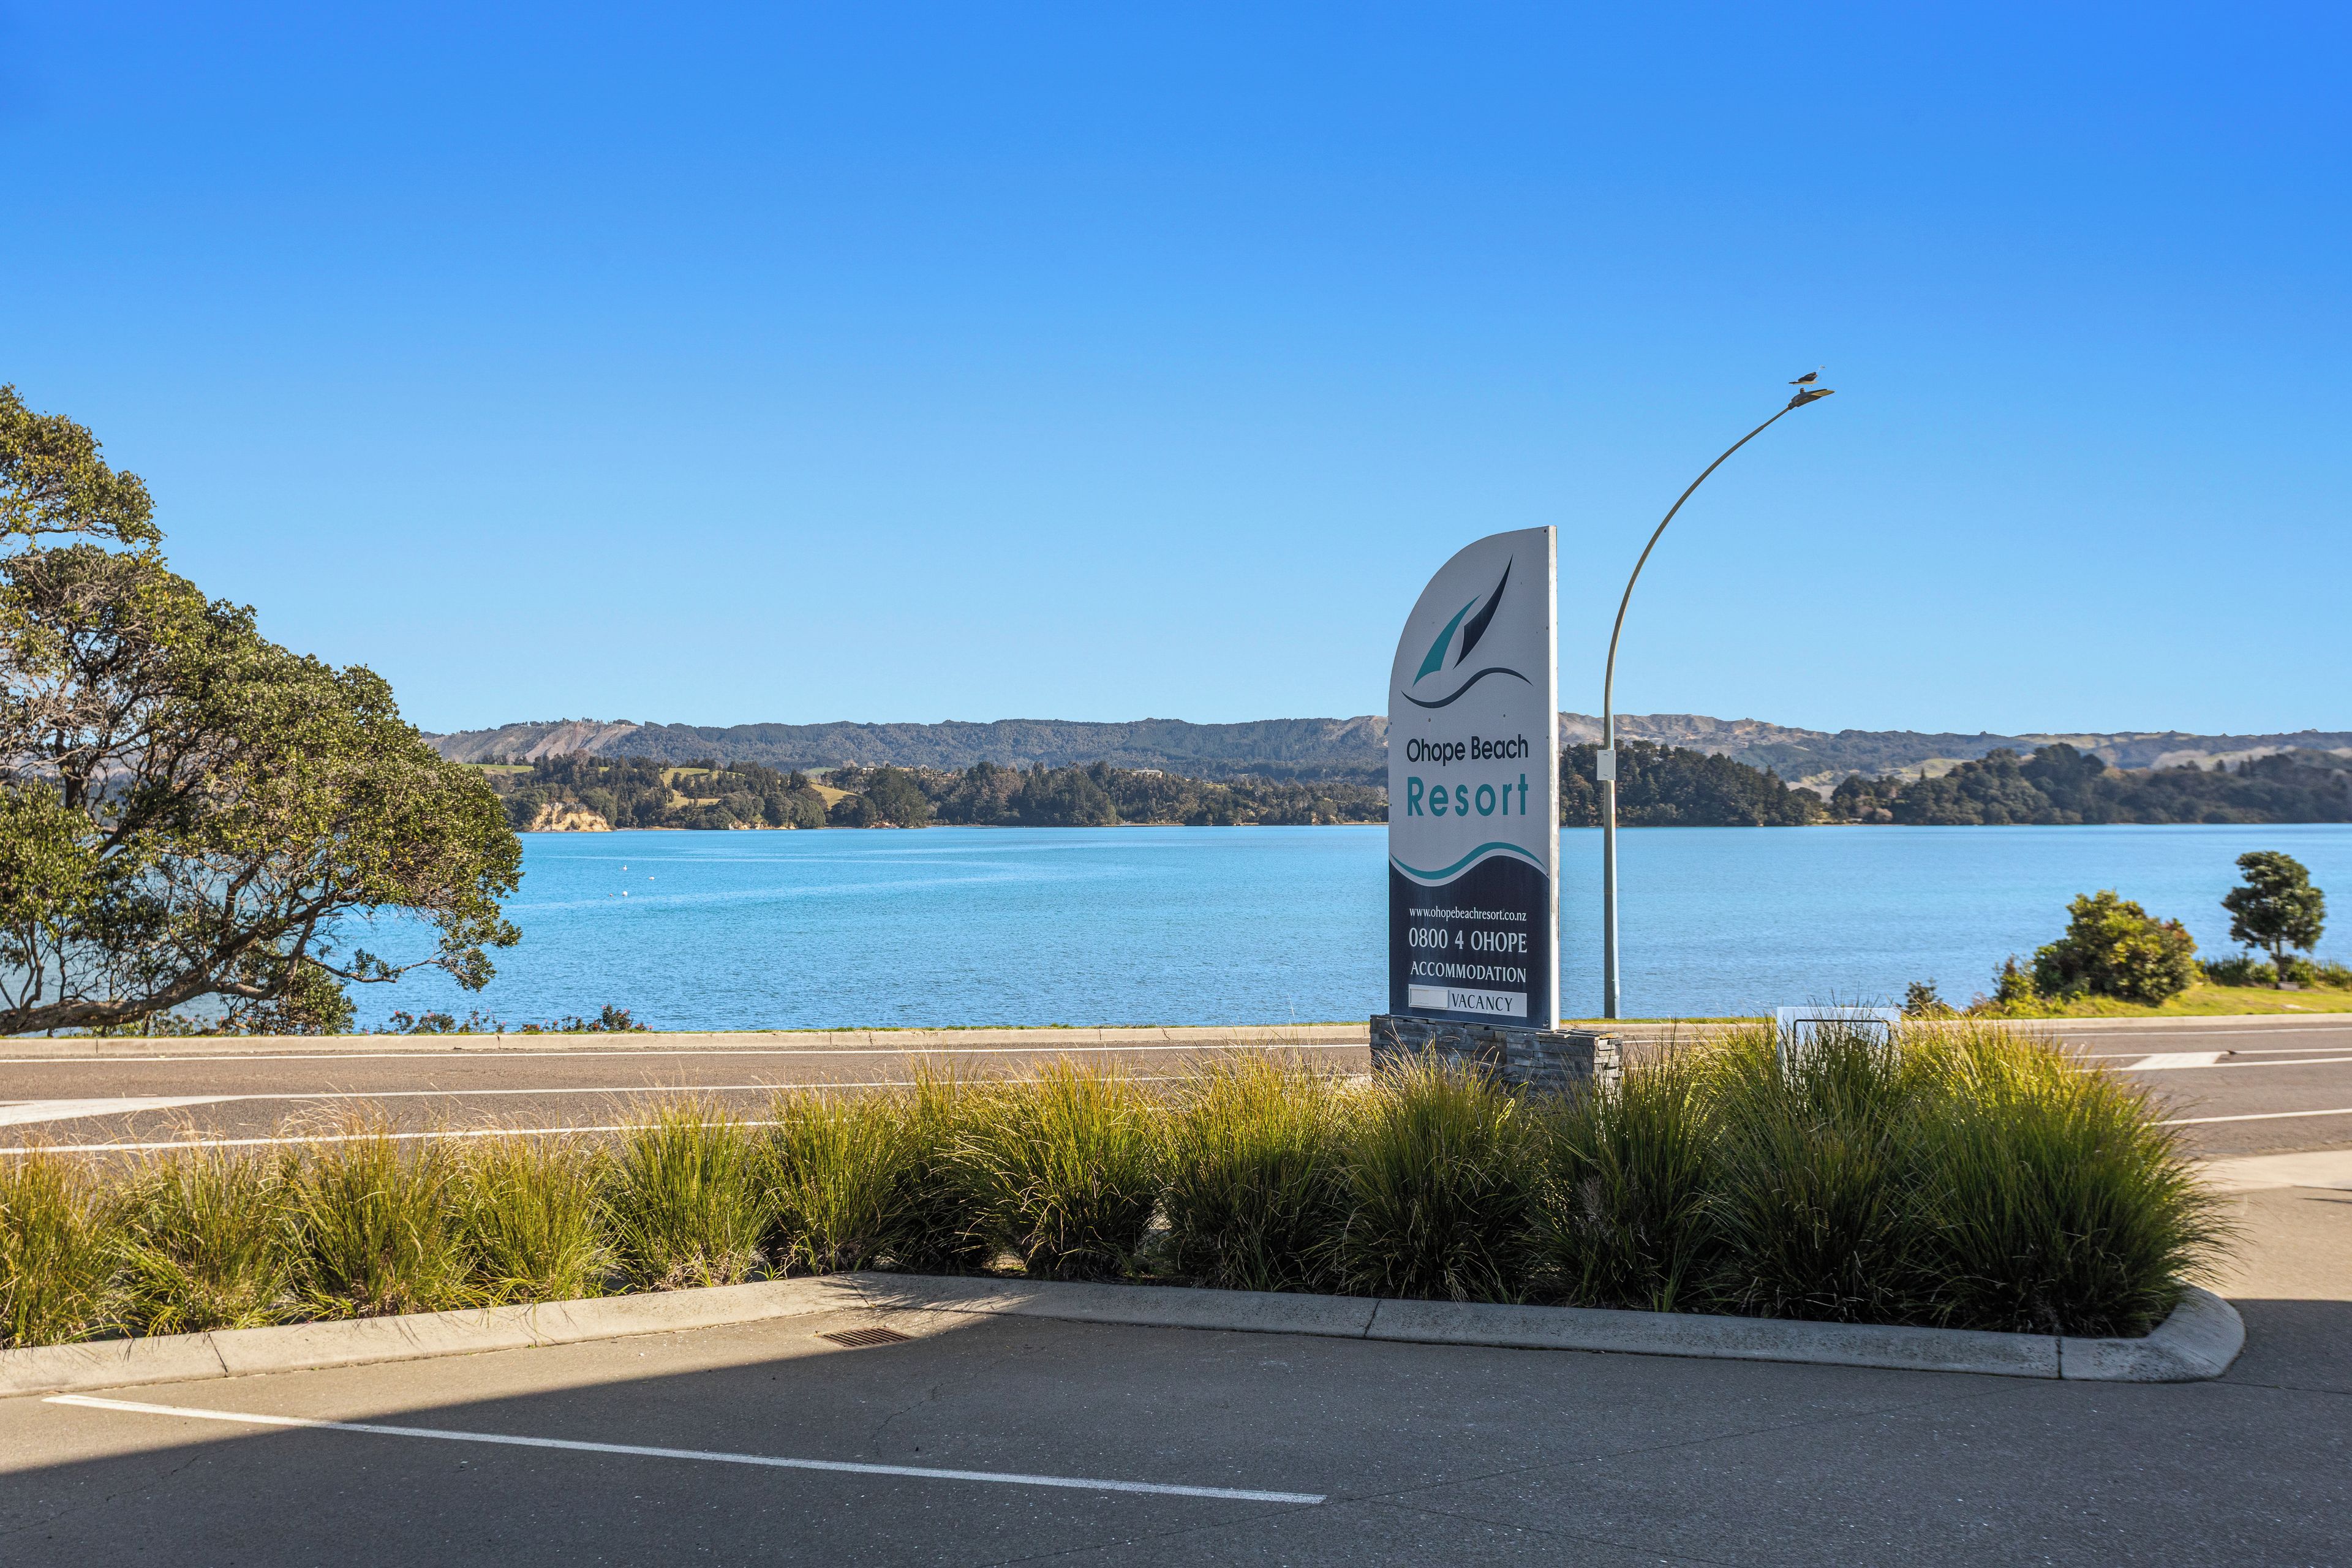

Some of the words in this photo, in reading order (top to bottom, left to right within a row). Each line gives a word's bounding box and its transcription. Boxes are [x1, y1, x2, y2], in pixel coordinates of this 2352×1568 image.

[1407, 739, 1465, 766] Ohope
[1471, 734, 1528, 760] Beach
[1408, 774, 1528, 816] Resort
[1409, 906, 1527, 921] www.ohopebeachresort.co.nz
[1409, 927, 1448, 949] 0800
[1455, 930, 1464, 949] 4
[1471, 930, 1528, 953] OHOPE
[1410, 961, 1526, 983] ACCOMMODATION
[1452, 993, 1513, 1012] VACANCY
